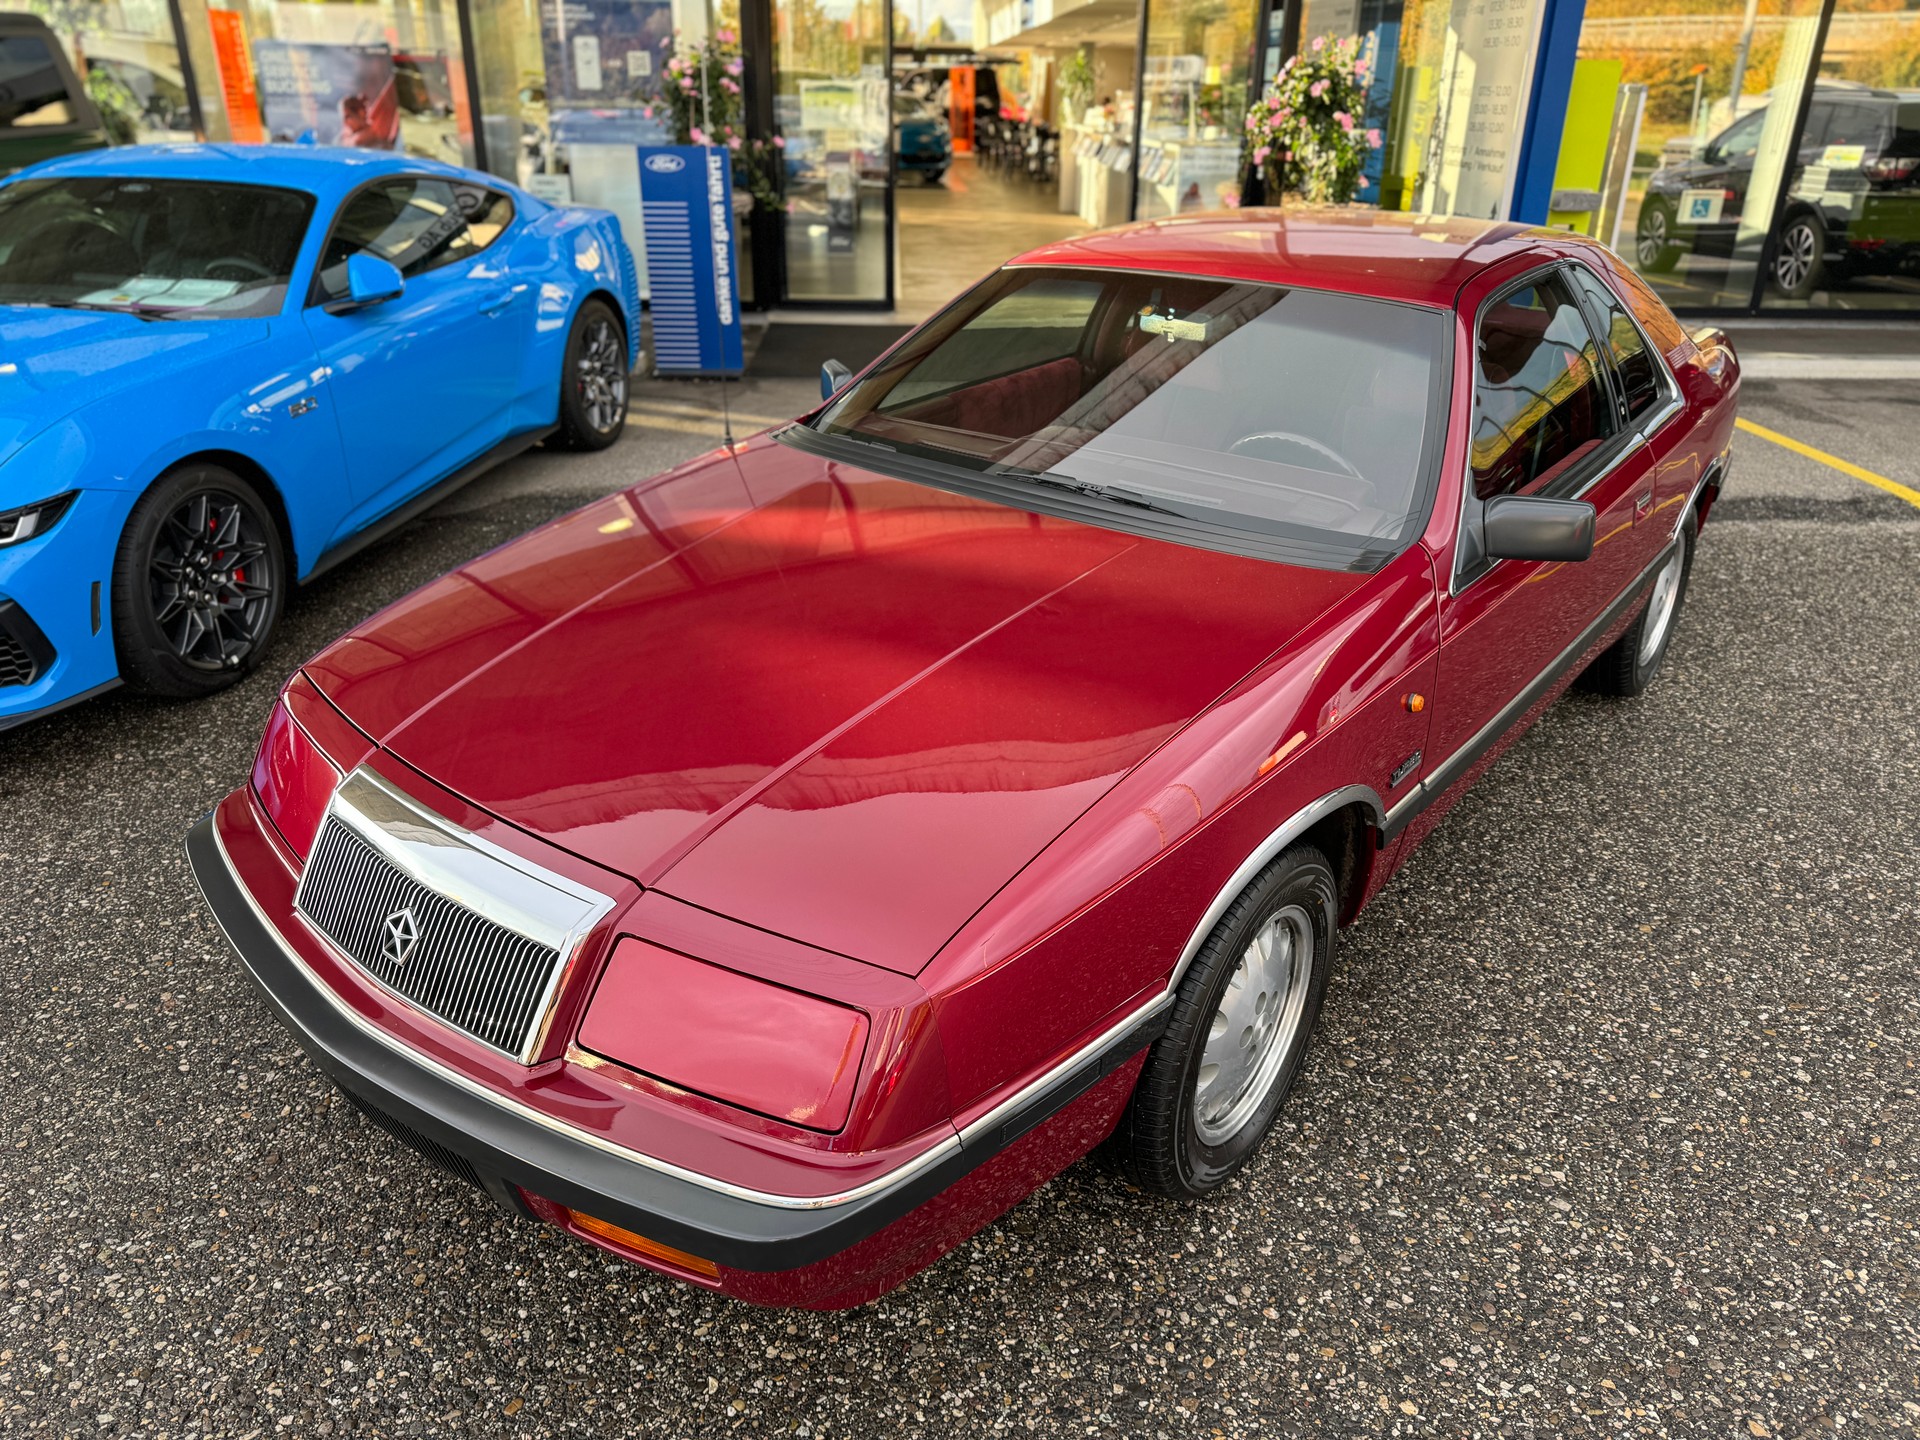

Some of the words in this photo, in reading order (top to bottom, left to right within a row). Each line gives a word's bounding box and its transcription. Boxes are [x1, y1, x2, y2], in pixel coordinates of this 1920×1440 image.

[649, 154, 682, 172] Ford
[712, 204, 730, 242] gute
[715, 242, 730, 275] und
[718, 276, 733, 326] danke
